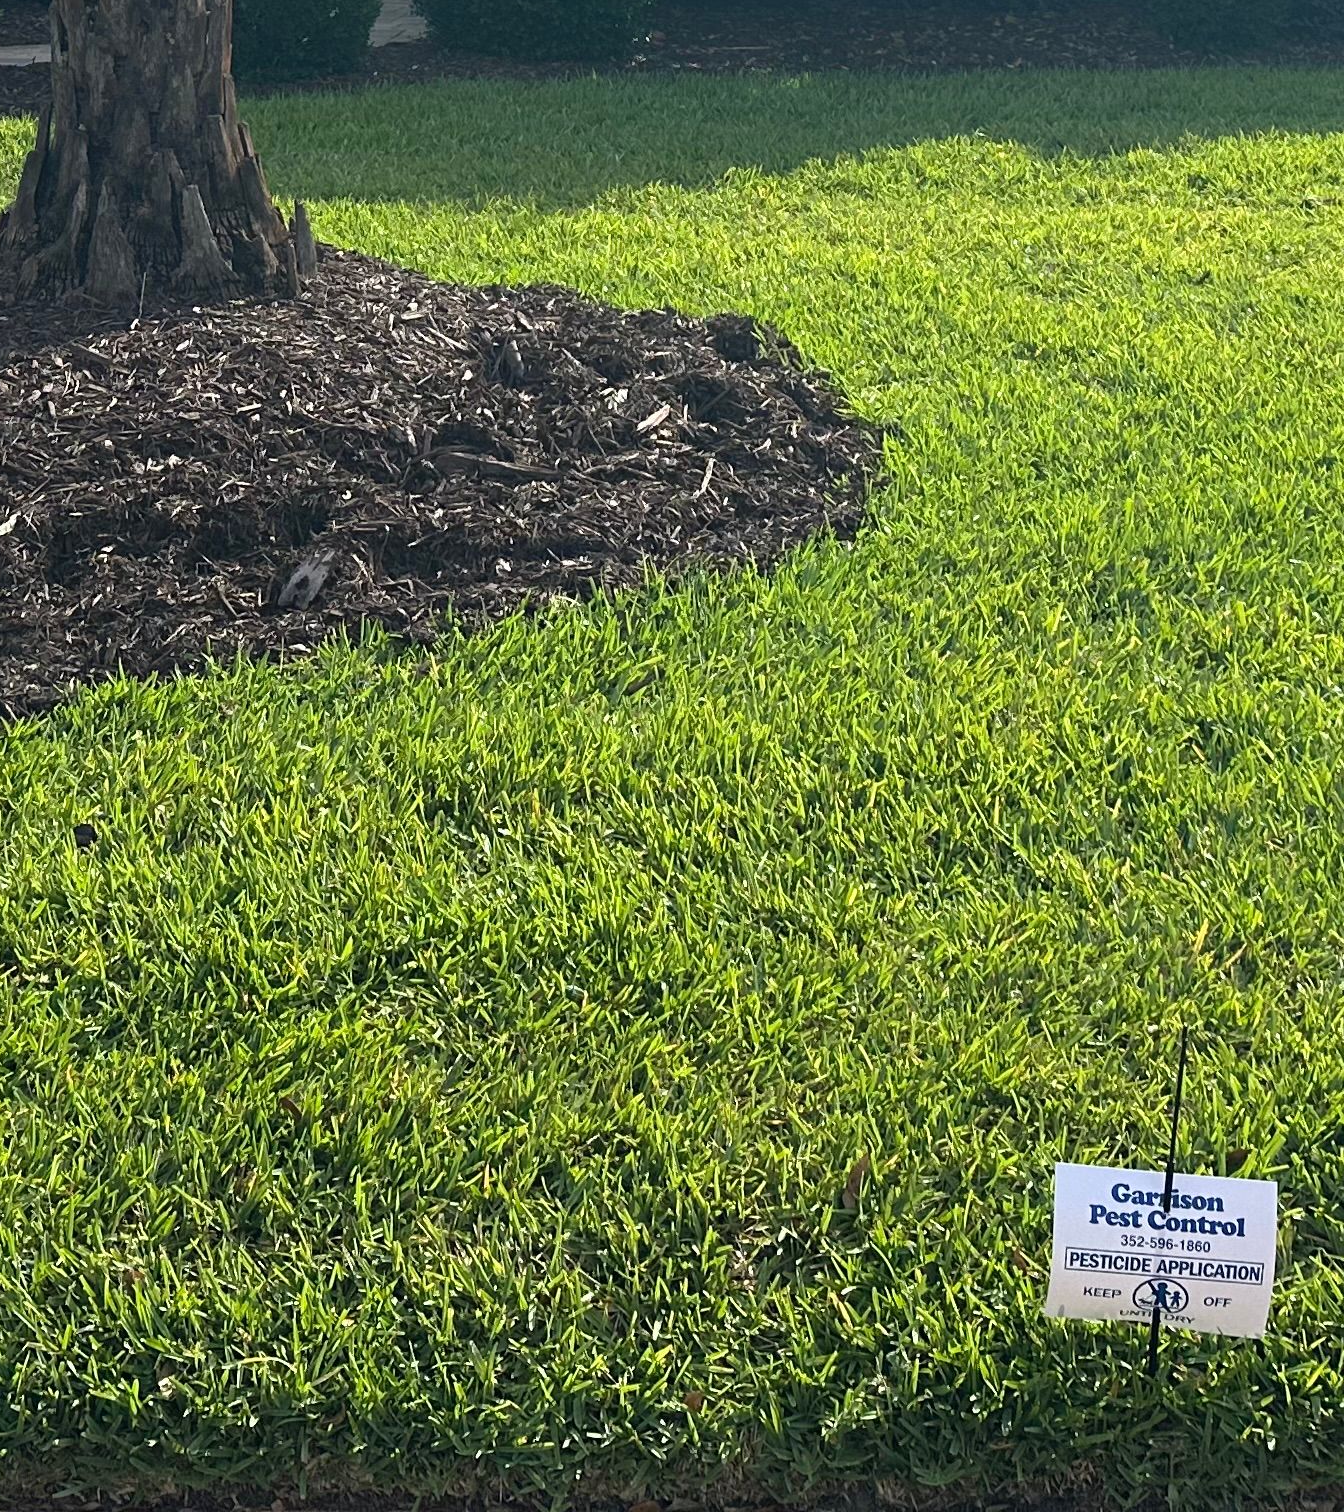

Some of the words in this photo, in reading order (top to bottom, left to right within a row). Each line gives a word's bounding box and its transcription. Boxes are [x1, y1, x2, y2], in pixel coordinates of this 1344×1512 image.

[1089, 1204, 1142, 1228] Pest
[1148, 1211, 1246, 1237] Control
[1120, 1234, 1211, 1253] 352-596-1860
[1069, 1251, 1153, 1273] PESTICIDE
[1156, 1259, 1261, 1282] APPLICATION
[1083, 1286, 1122, 1299] KEEP
[1203, 1296, 1233, 1309] OFF
[1119, 1309, 1152, 1318] UNTI
[1164, 1313, 1196, 1325] DRY
